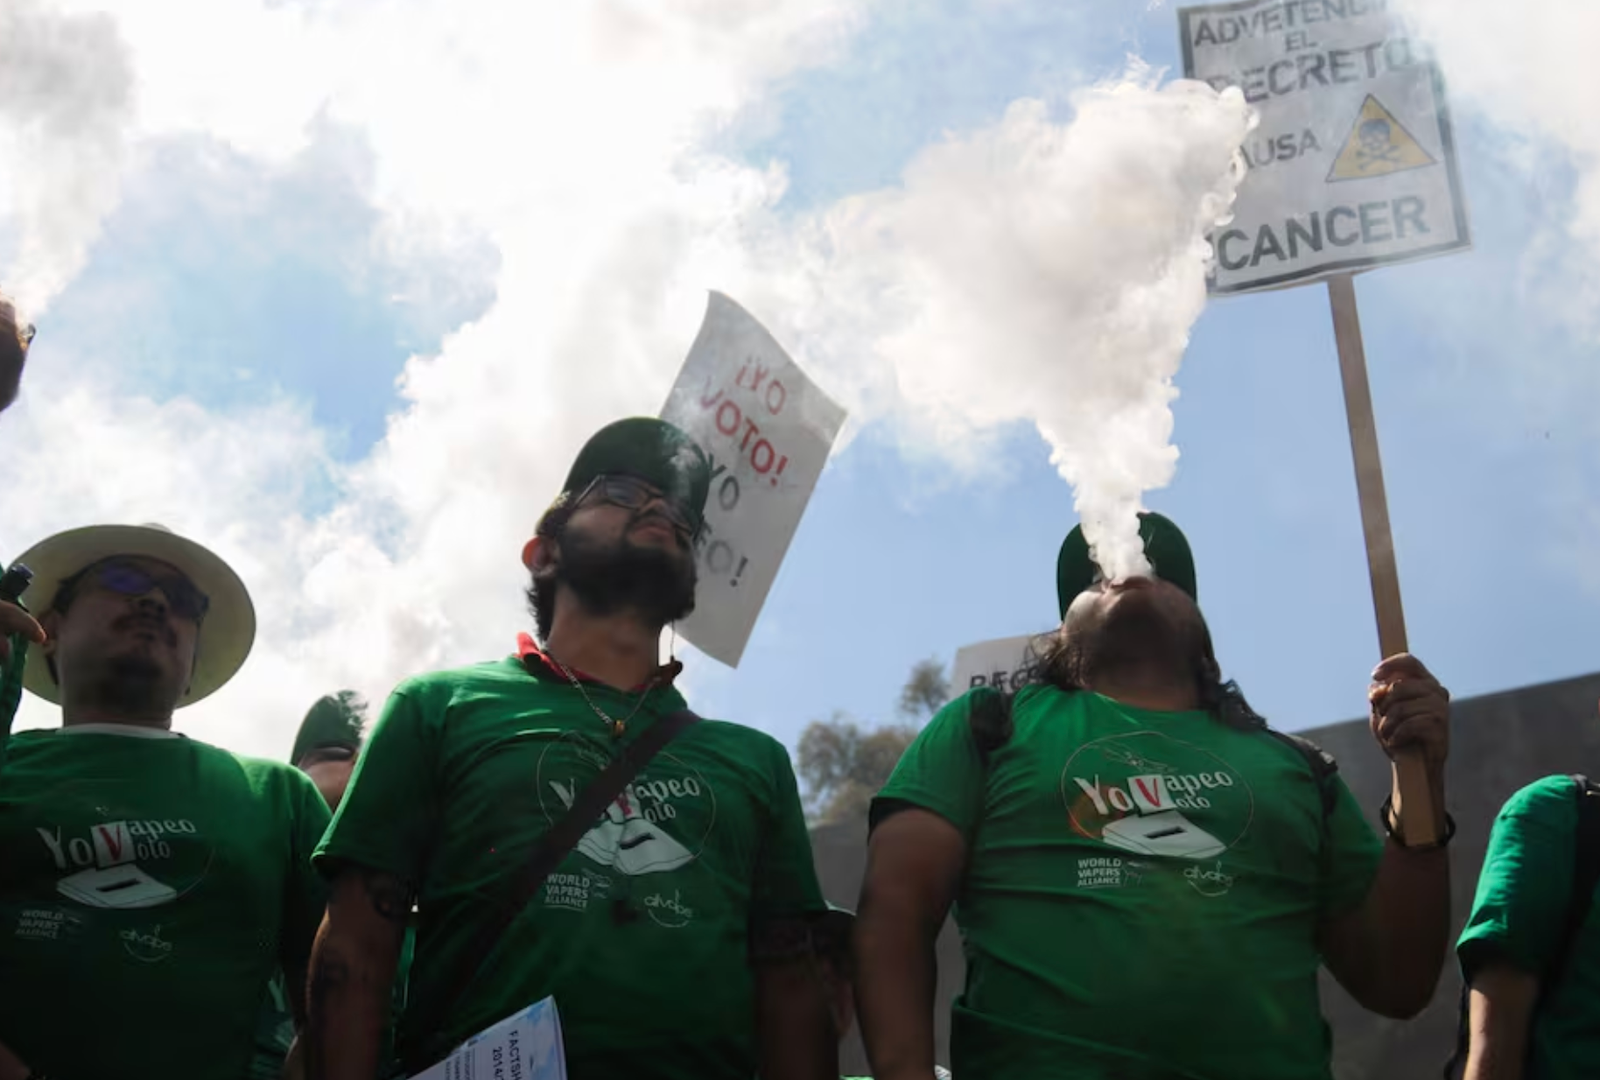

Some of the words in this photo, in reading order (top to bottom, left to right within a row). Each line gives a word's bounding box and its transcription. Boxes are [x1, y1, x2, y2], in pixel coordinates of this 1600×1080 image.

[1286, 30, 1318, 52] EL
[1216, 195, 1431, 271] CANCER
[700, 377, 789, 487] VOTO!
[1077, 857, 1122, 868] WORLD
[1077, 868, 1121, 878] VAPERS
[547, 873, 591, 888] WORLD
[1077, 876, 1121, 887] ALLIANCE
[546, 885, 589, 899] VAPERS
[544, 895, 587, 908] ALLIANCE
